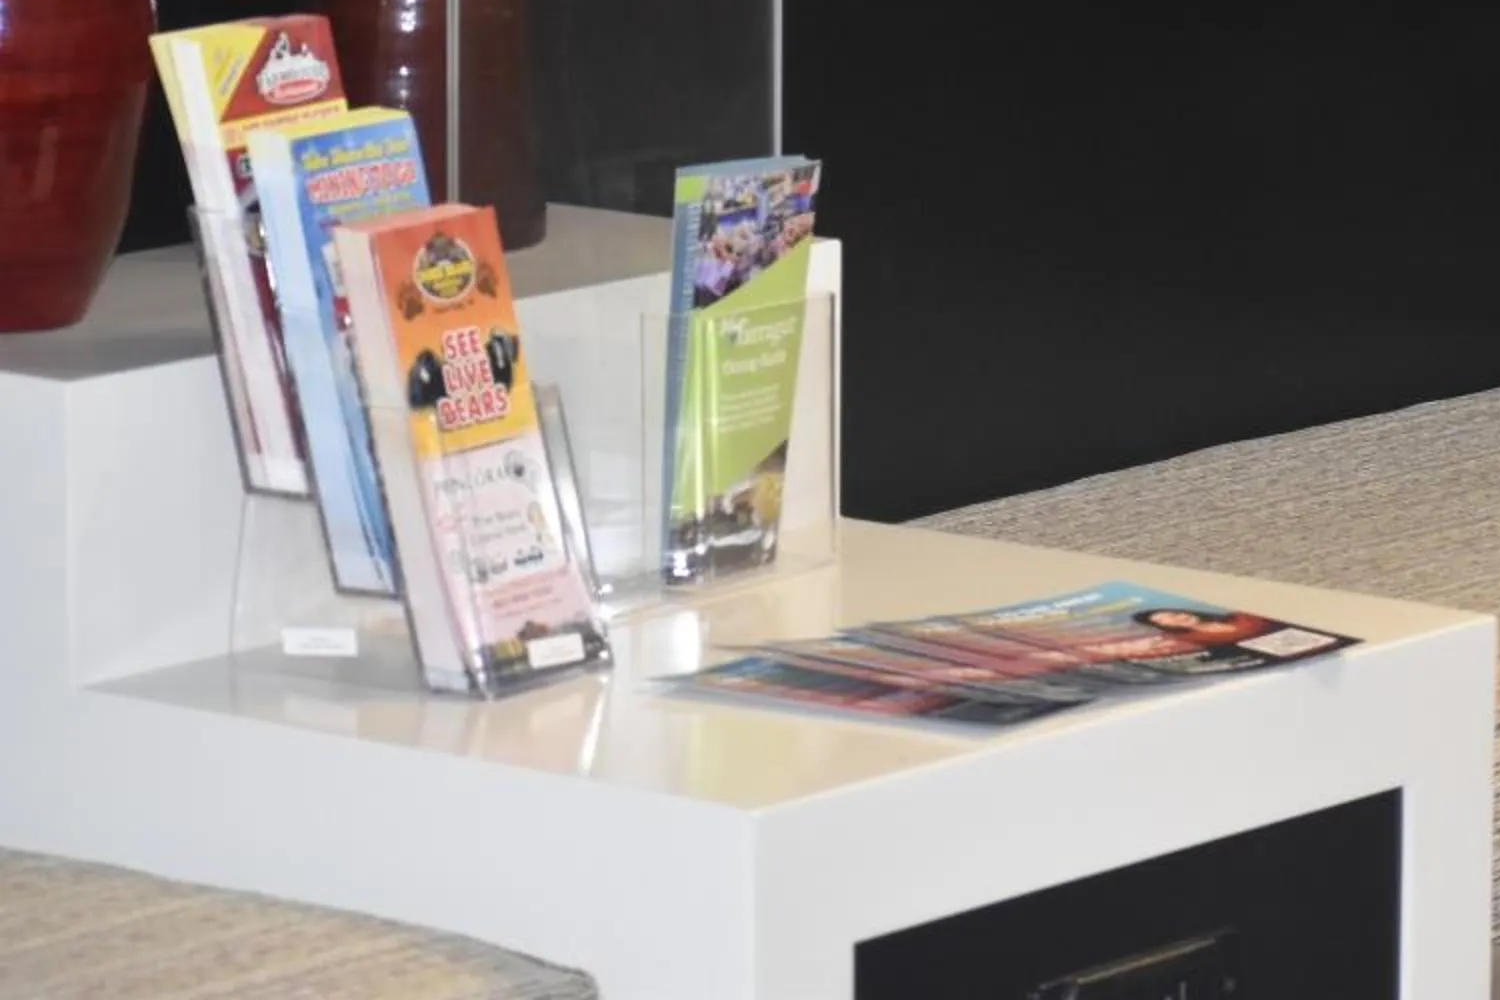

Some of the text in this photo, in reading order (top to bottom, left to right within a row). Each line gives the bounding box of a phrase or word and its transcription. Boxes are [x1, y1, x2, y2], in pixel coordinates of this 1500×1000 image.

[443, 328, 481, 360] SEE
[443, 358, 492, 394] LIVE
[437, 385, 511, 428] BEARS
